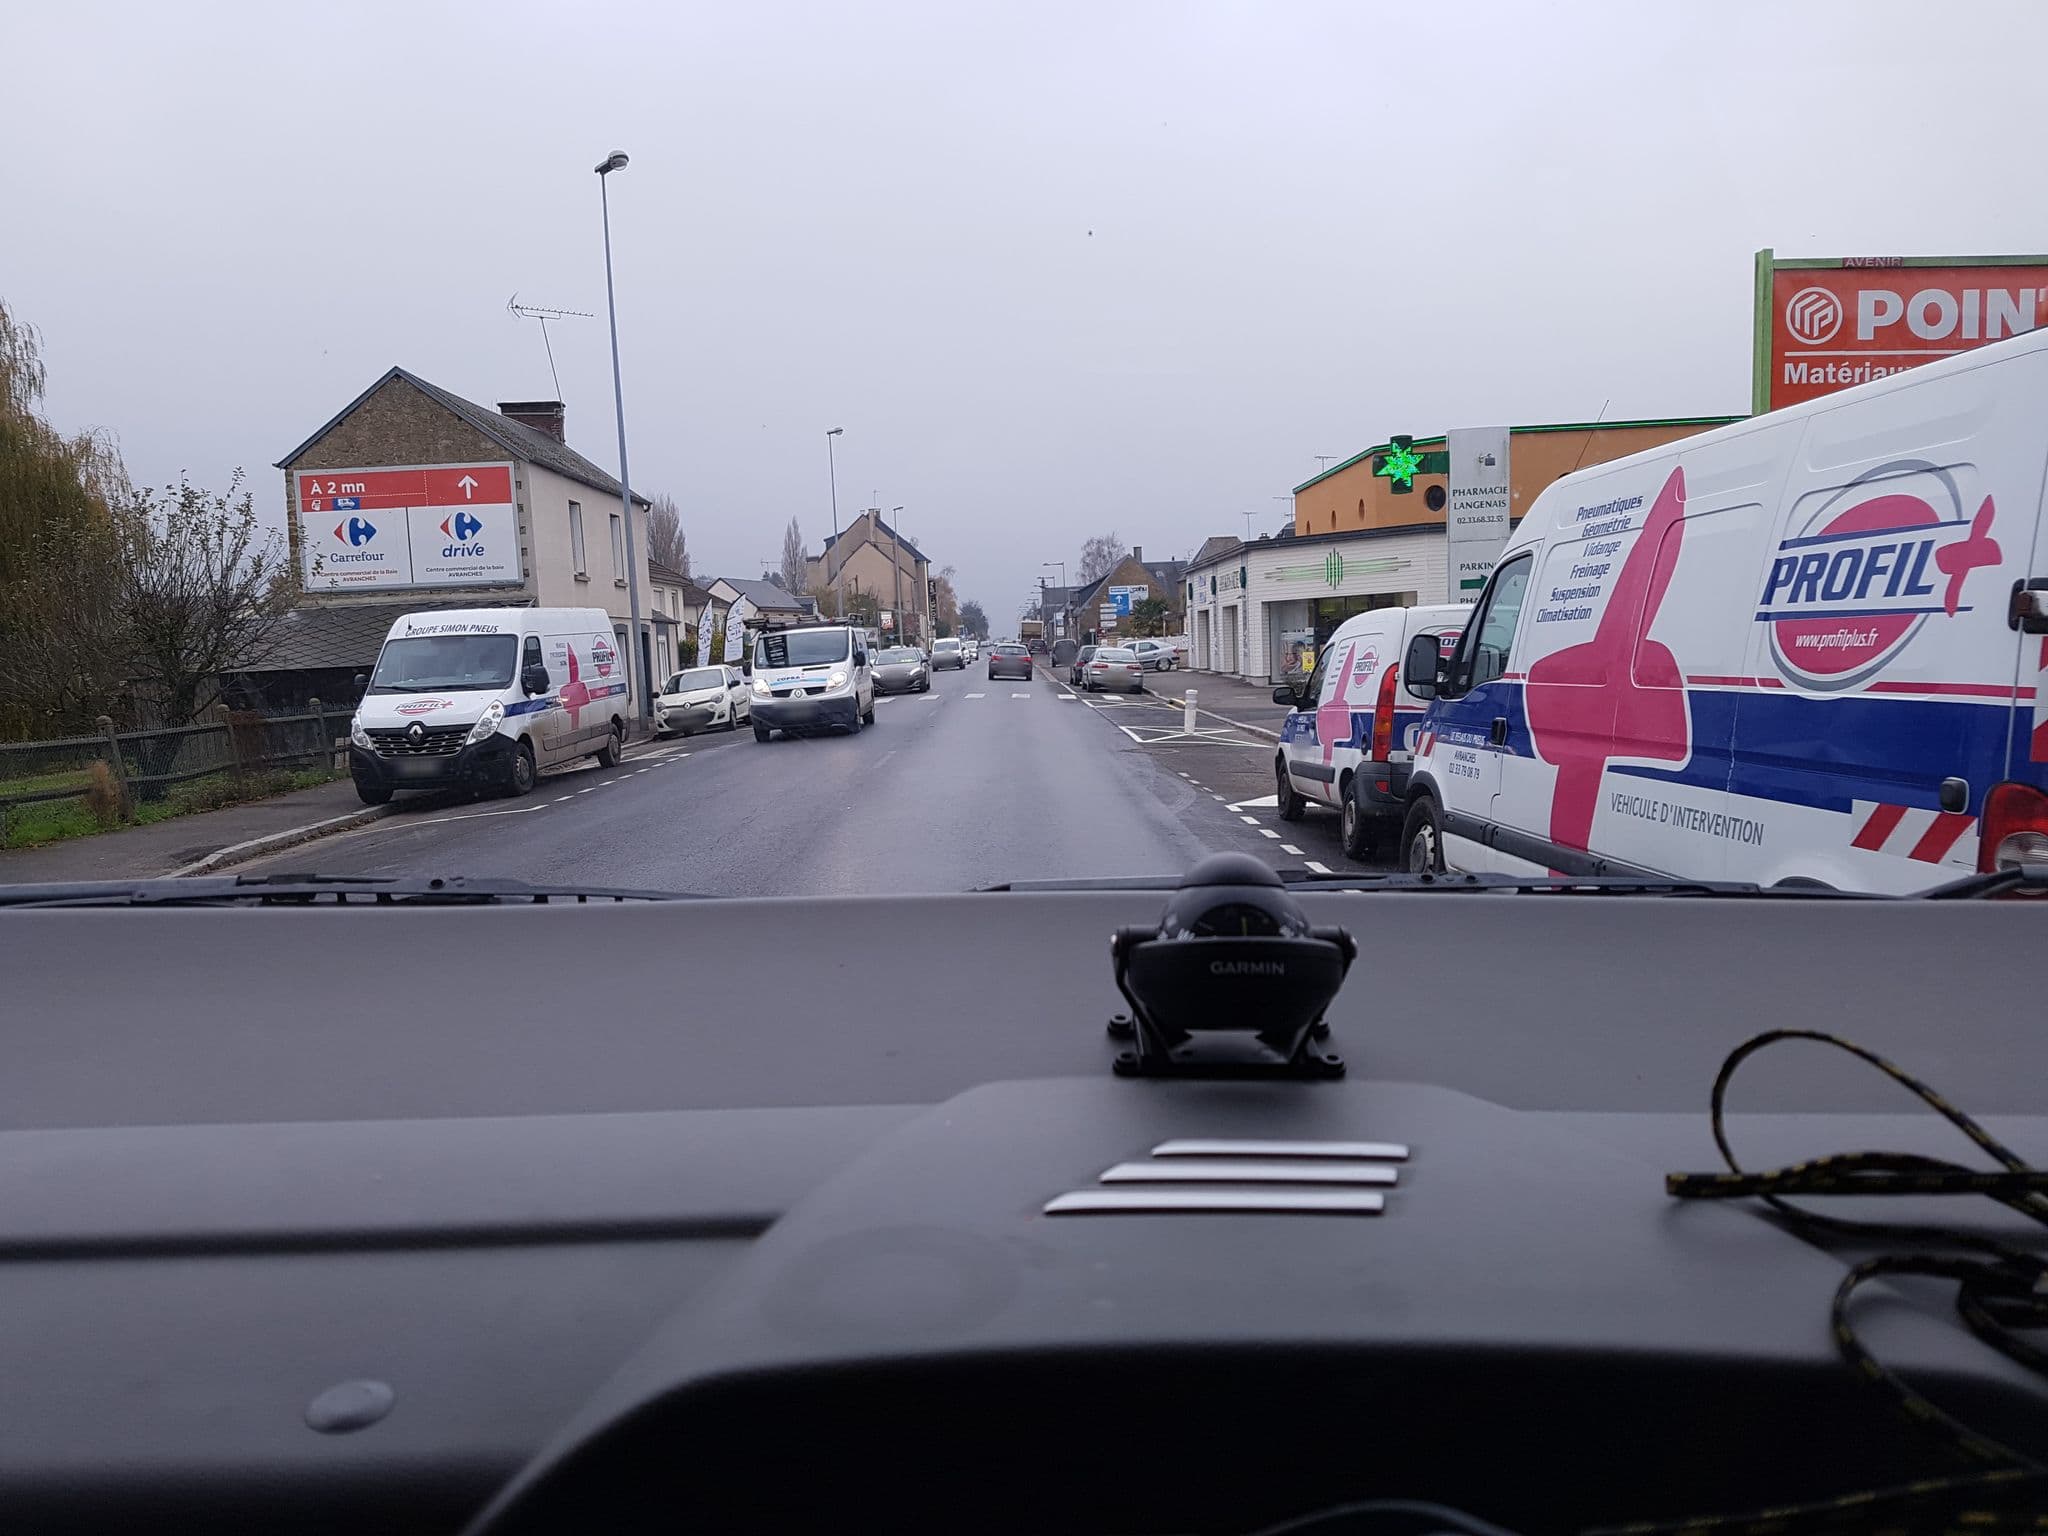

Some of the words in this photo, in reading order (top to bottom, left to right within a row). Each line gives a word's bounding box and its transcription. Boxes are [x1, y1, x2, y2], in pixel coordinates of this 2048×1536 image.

[1844, 257, 1903, 267] AVENIR
[327, 481, 337, 494] 2
[341, 482, 366, 493] mn
[1452, 486, 1509, 497] PHARMACIE
[1453, 499, 1507, 510] LANGENAIS
[1575, 495, 1644, 522] Pneumatiques
[442, 542, 485, 558] drive
[1582, 540, 1622, 557] Vidange
[330, 551, 385, 563] Carrefour
[1460, 562, 1497, 571] PARKIN
[1569, 562, 1611, 580] Freinage
[1550, 583, 1601, 604] Suspension
[1536, 605, 1592, 623] Climatisation
[439, 624, 469, 633] SIMON
[469, 624, 499, 634] PNEUS
[1795, 628, 1879, 652] www.profilplus.fr
[1611, 792, 1659, 821] VEHICULE
[1659, 803, 1764, 846] D'INTERVENTION
[1210, 960, 1285, 975] GARMIN
